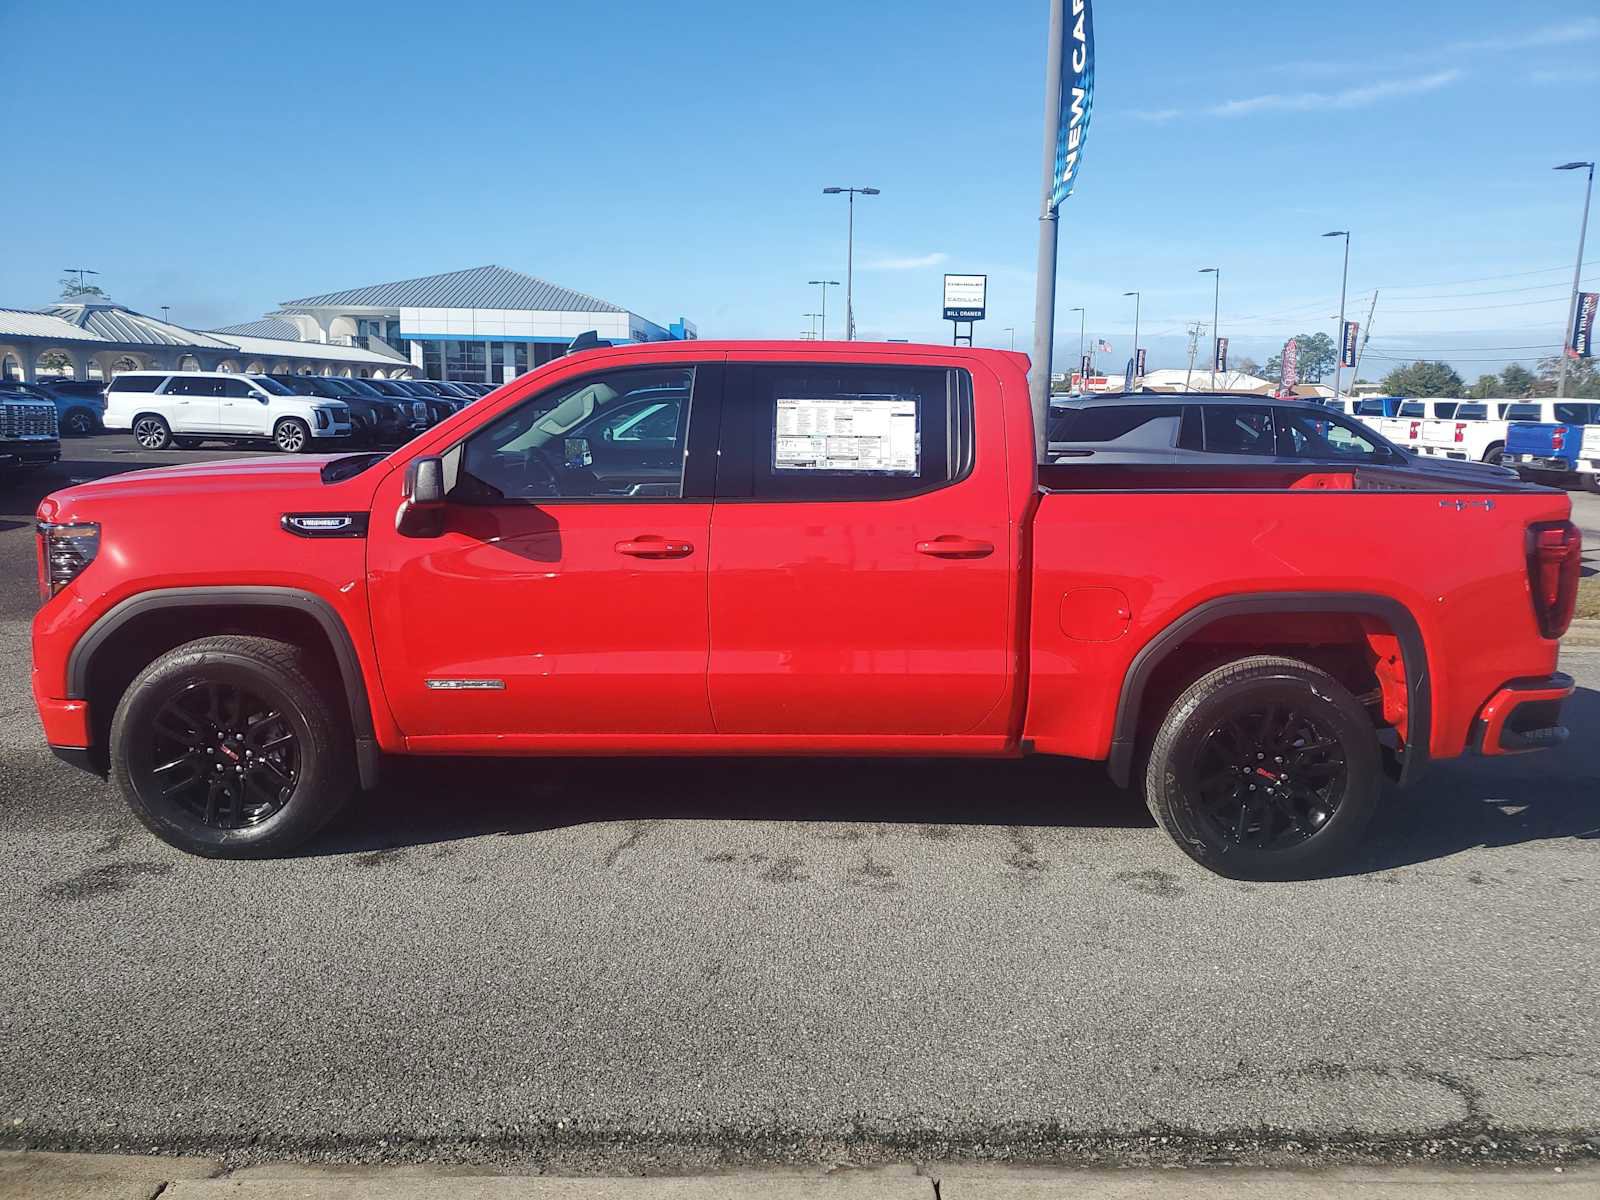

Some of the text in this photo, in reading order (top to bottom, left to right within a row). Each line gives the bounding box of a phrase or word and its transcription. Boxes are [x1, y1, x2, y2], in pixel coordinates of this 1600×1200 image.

[1063, 88, 1085, 182] NEW
[1576, 296, 1593, 354] NEW TRUCKS
